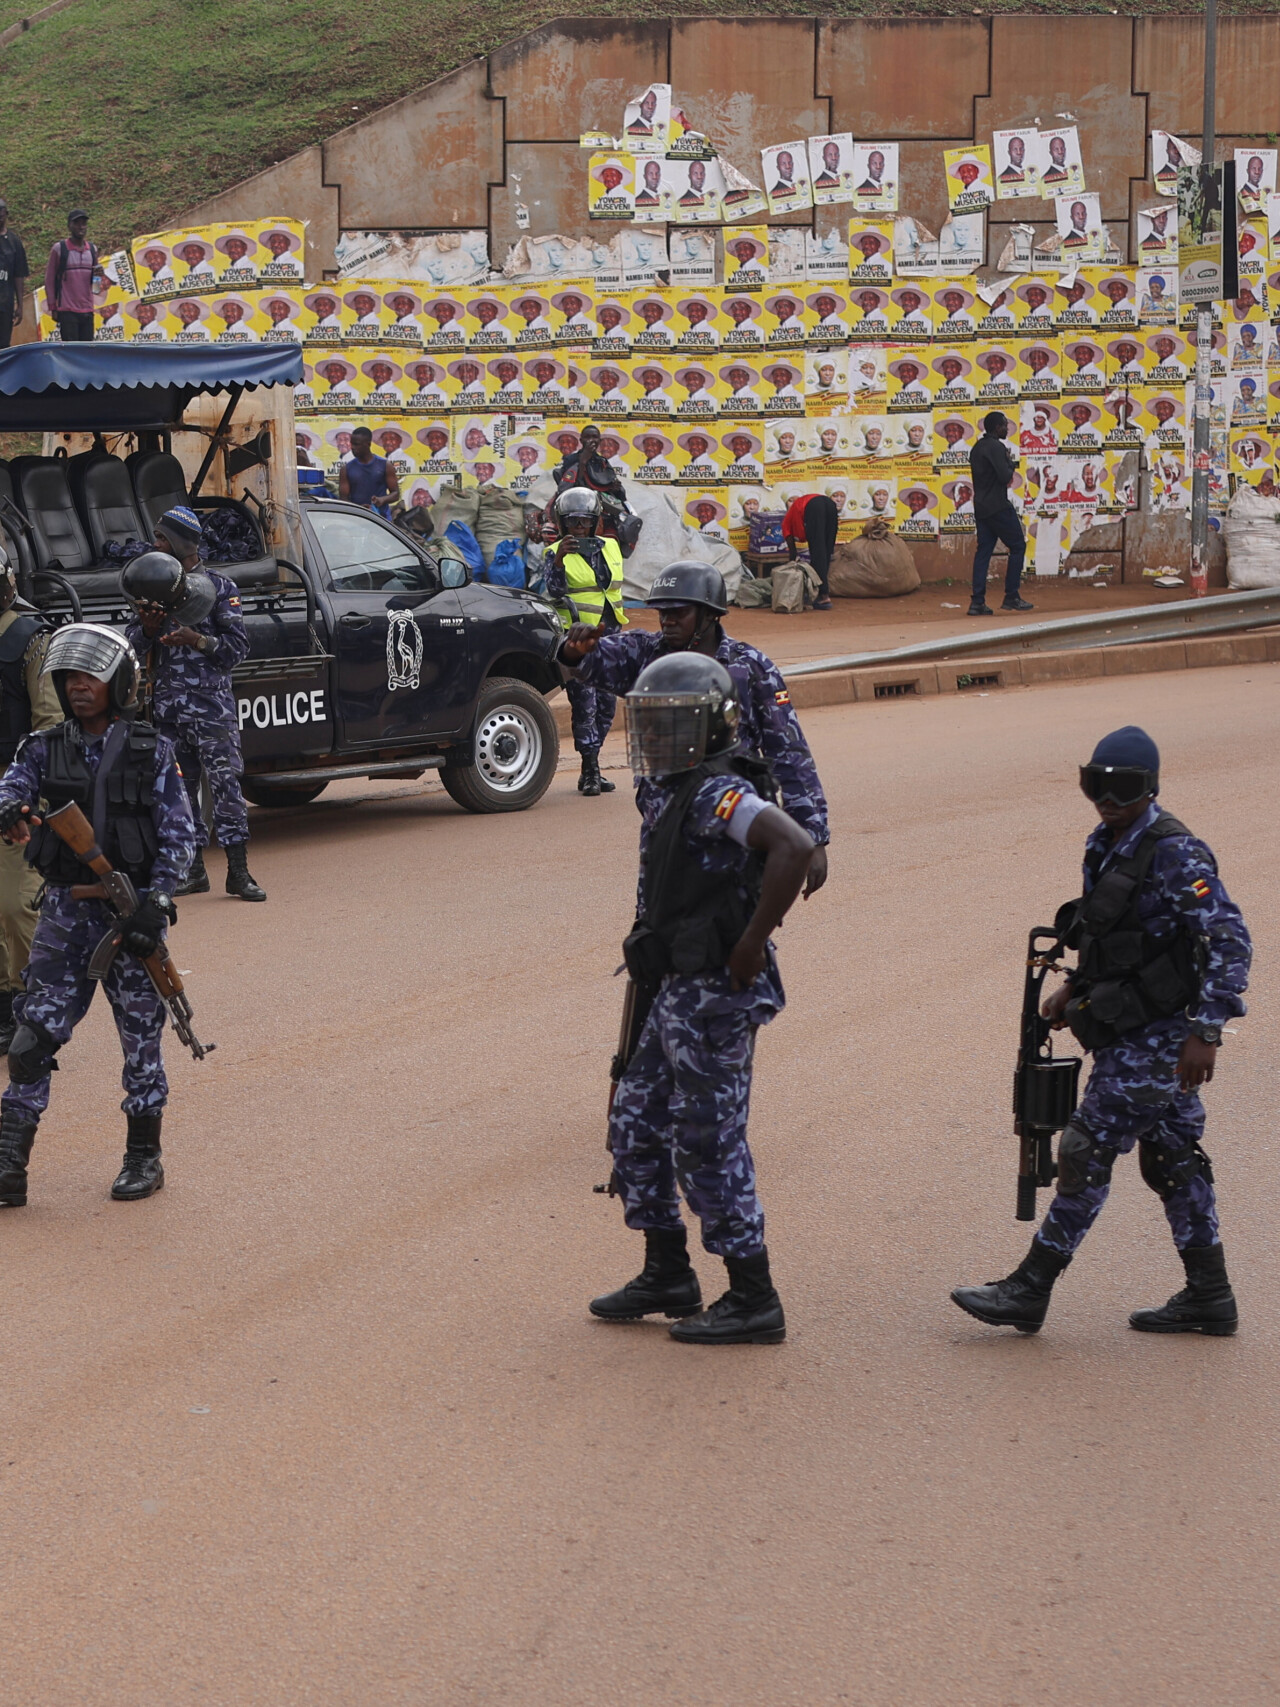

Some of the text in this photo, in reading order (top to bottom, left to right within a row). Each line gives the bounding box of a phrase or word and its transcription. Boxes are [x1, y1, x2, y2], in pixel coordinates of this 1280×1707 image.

[954, 197, 990, 206] MUSEVENI
[1182, 286, 1219, 297] 0800299000
[1056, 316, 1092, 324] MUSEVENI
[891, 326, 927, 334] MUSEVENI
[977, 322, 1014, 330] MUSEVENI
[1018, 322, 1052, 330] MUSEVENI
[555, 330, 592, 338] MUSEVENI
[769, 333, 804, 342] MUSEVENI
[593, 343, 629, 351] MUSEVENI
[654, 577, 677, 588] OLICE
[238, 690, 326, 730] POLICE
